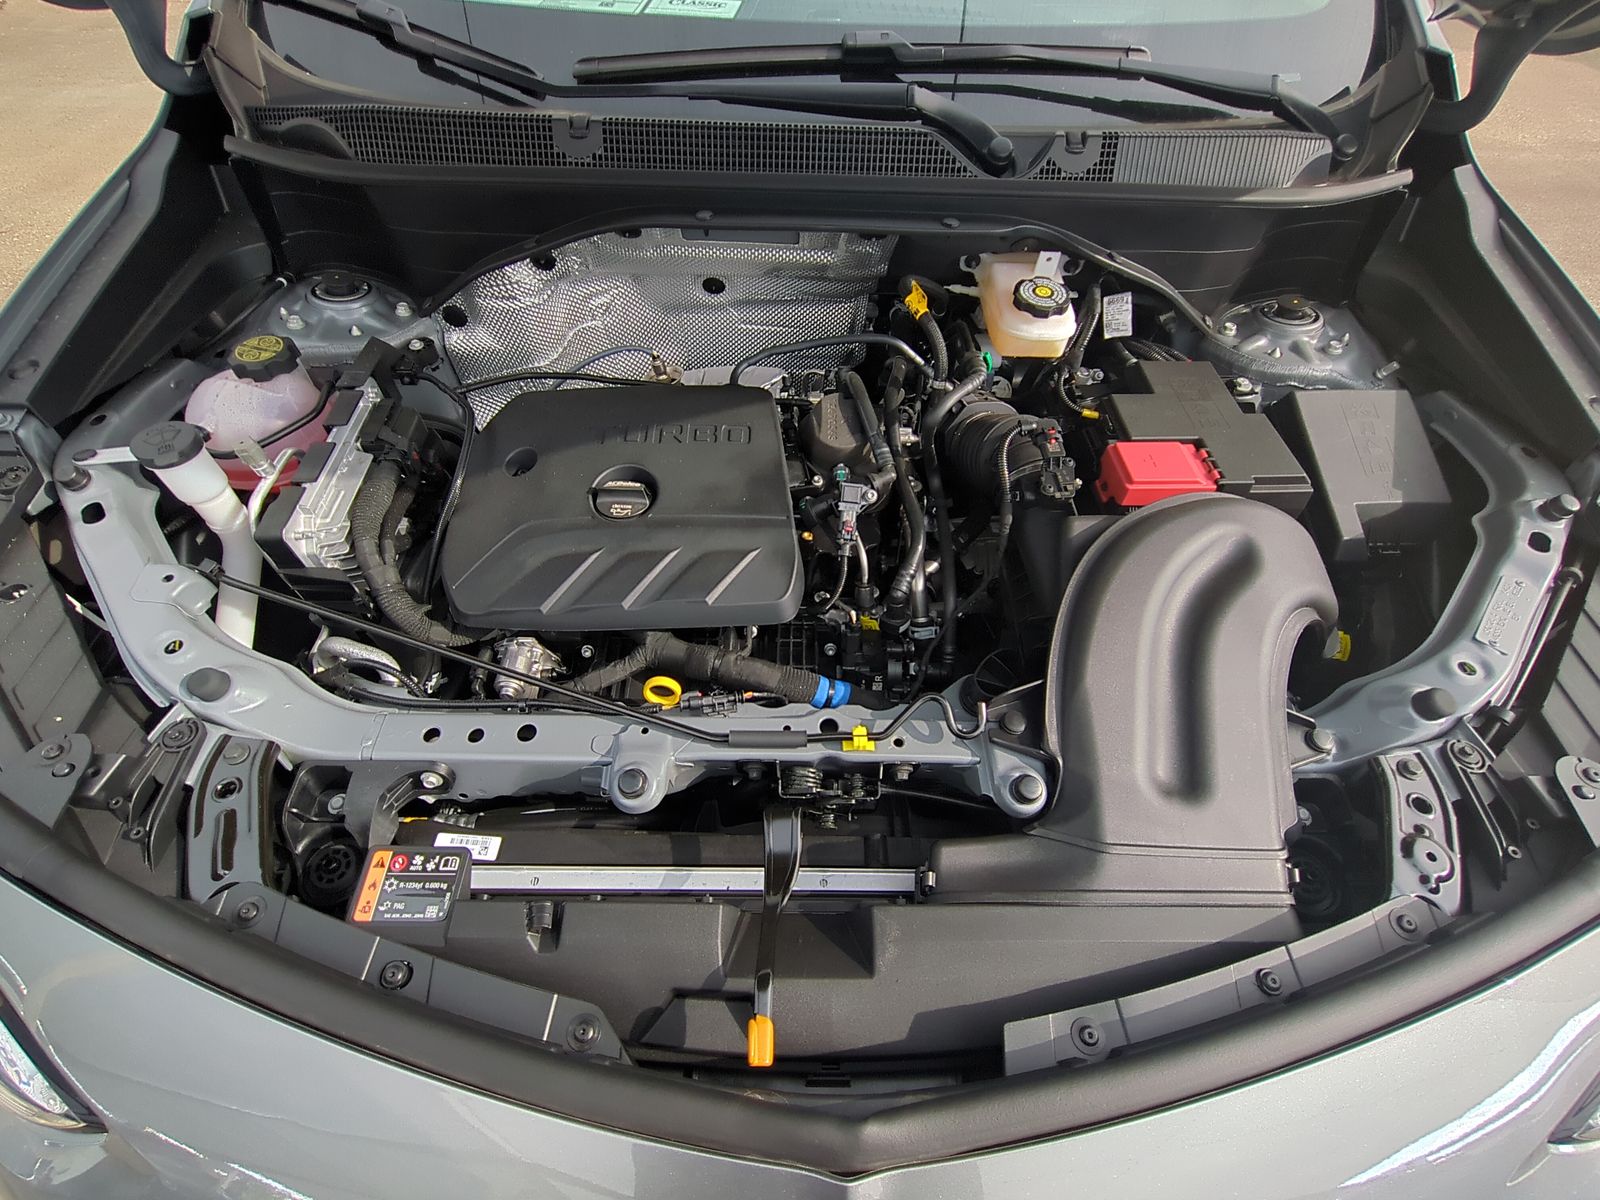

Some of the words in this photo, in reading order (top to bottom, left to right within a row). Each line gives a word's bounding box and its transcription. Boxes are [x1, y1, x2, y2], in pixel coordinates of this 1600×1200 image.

[589, 423, 752, 445] TURBO
[398, 881, 424, 890] R-1234yf
[424, 881, 440, 889] 0.600
[439, 882, 448, 890] kg
[392, 902, 406, 910] PAG
